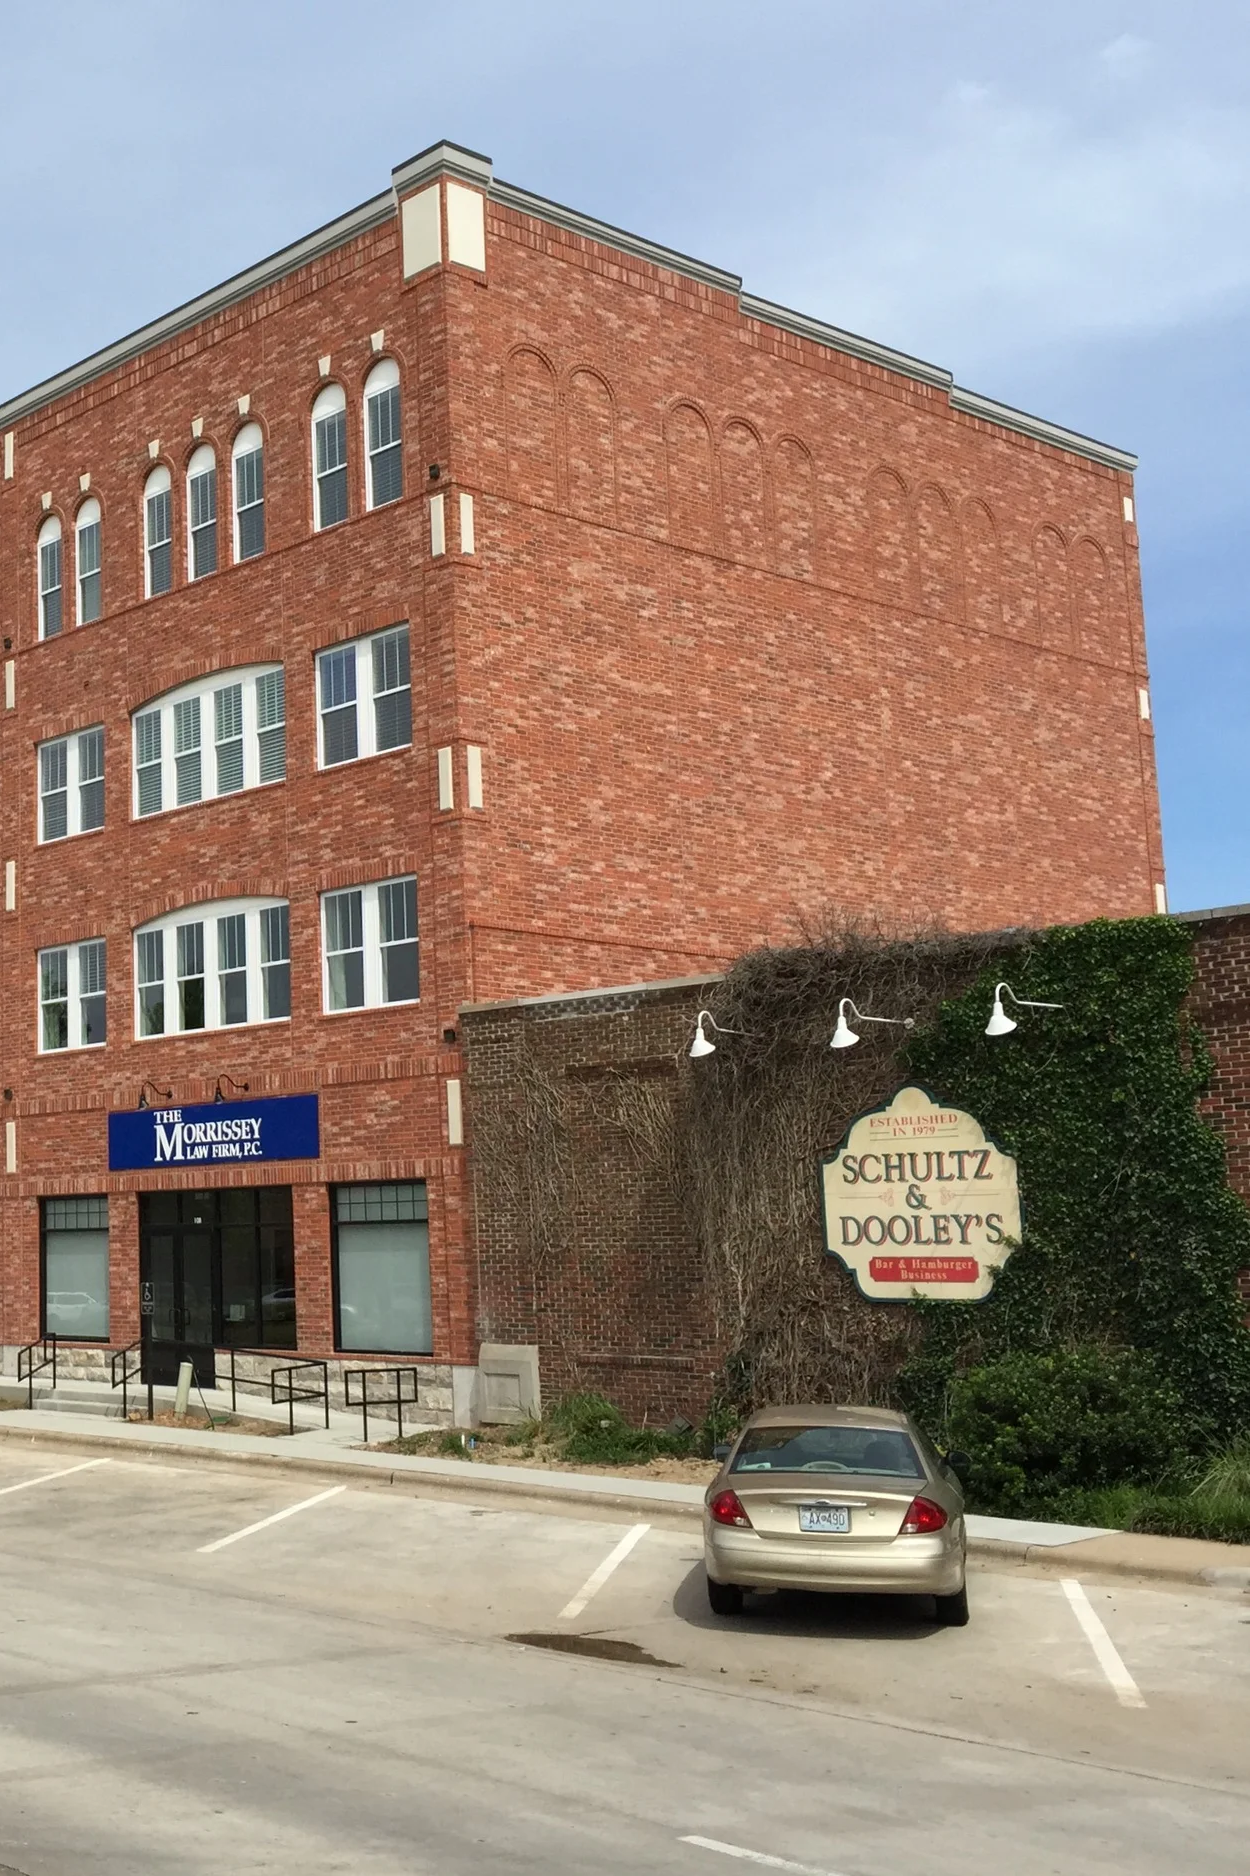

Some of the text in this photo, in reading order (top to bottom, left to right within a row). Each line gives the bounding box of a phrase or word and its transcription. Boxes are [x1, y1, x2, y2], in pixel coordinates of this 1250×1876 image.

[153, 1109, 182, 1124] THE
[869, 1113, 958, 1128] ESTABLISHED
[153, 1117, 263, 1162] MORRISSEY
[892, 1126, 936, 1137] IN 1979
[186, 1141, 263, 1160] LAW FIRM, P.C.
[842, 1149, 994, 1185] SCHULTZ
[905, 1183, 932, 1211] &
[839, 1213, 1005, 1247] DOOLEY'S
[875, 1259, 973, 1271] Bar & Hamburger
[900, 1269, 948, 1280] Business
